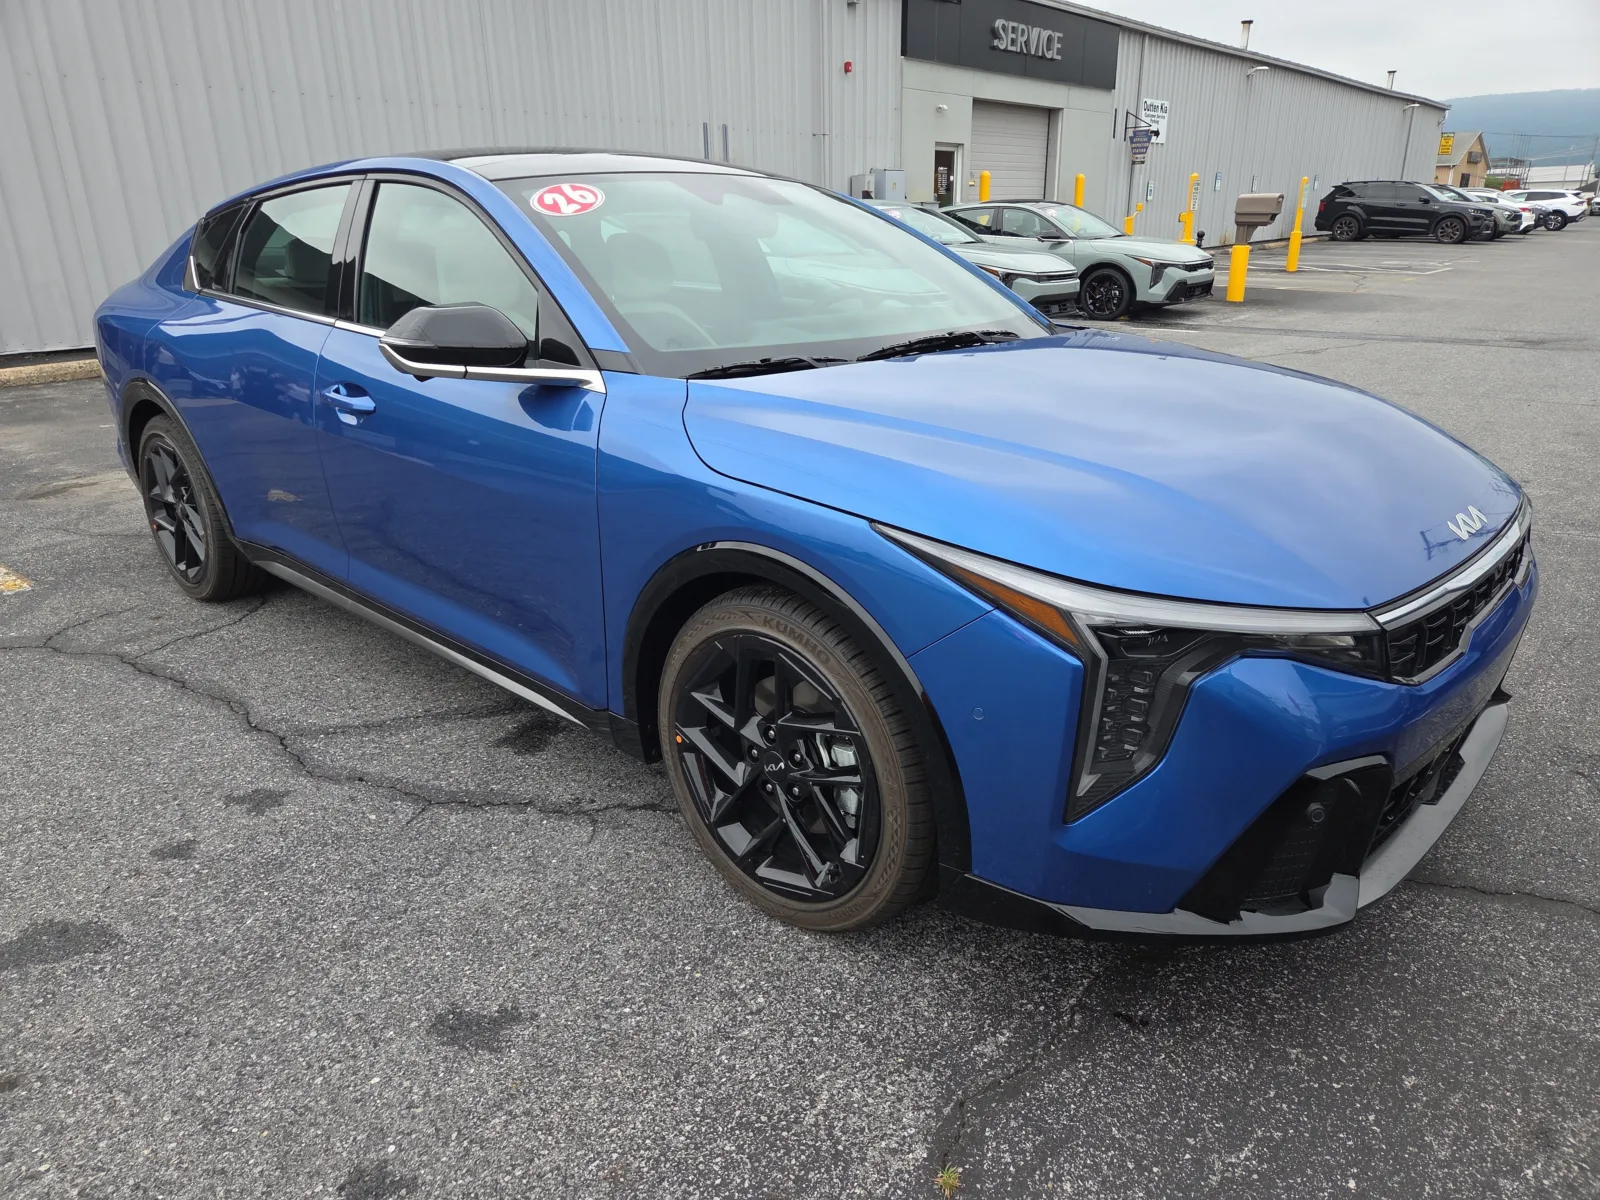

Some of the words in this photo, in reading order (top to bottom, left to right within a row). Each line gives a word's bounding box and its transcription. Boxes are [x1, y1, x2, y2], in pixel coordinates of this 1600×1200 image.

[993, 18, 1063, 60] SERVICE
[543, 184, 597, 214] 26
[762, 615, 831, 665] KUMHO
